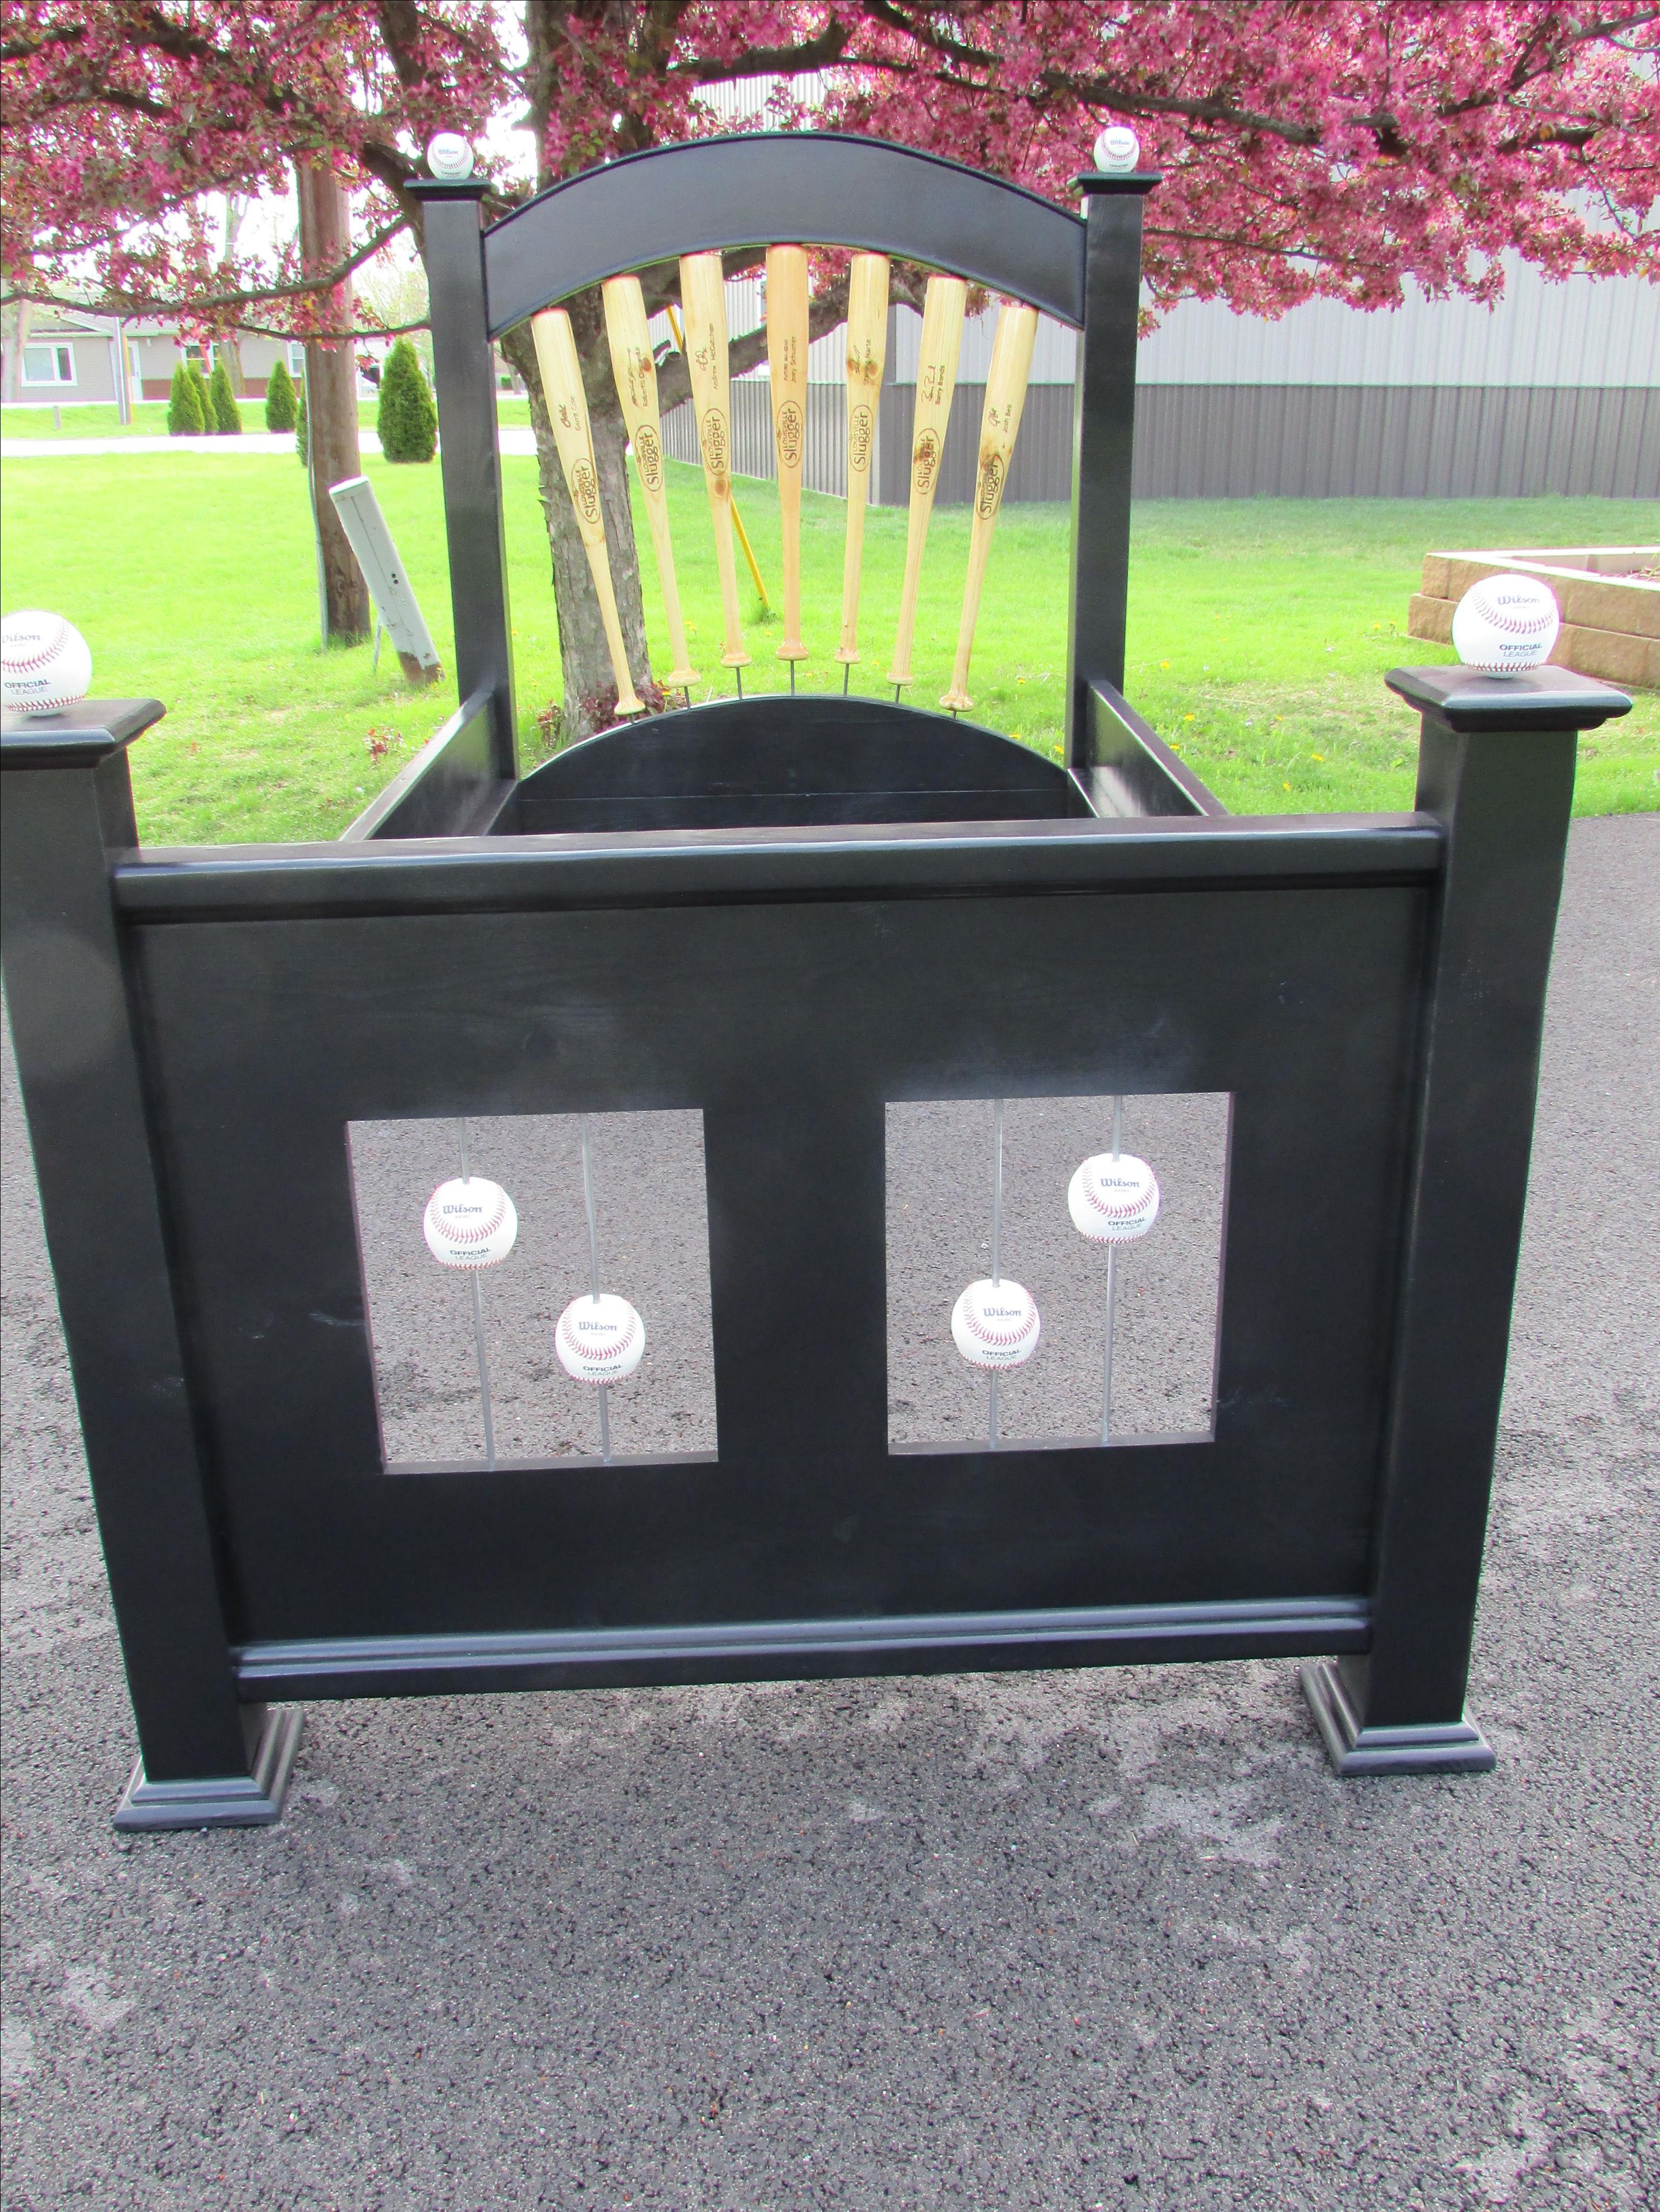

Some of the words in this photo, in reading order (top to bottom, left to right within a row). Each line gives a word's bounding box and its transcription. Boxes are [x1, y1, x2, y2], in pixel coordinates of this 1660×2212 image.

[937, 365, 946, 386] Bonds
[935, 387, 943, 405] Barry
[705, 419, 714, 456] LOUISVILLE
[710, 416, 725, 469] Slugger
[784, 408, 800, 461] Slugger
[854, 412, 871, 465] Slugger
[639, 435, 649, 473] LOUISVILLE
[643, 433, 659, 485] Slugger
[917, 435, 936, 488] Slugger
[575, 469, 588, 505] LOUISVILLE
[580, 465, 598, 518] Slugger
[980, 464, 1000, 514] Slugger
[1497, 595, 1540, 605] Wilson
[5, 679, 51, 688] OFFICIAL
[11, 686, 48, 695] LEAGUE
[1100, 1177, 1140, 1188] Wilson
[443, 1204, 483, 1214] Wilson
[1108, 1217, 1147, 1226] OFFICIAL
[450, 1248, 492, 1256] OFFICIAL
[983, 1307, 1022, 1317] Wilson
[578, 1321, 618, 1331] Wilson
